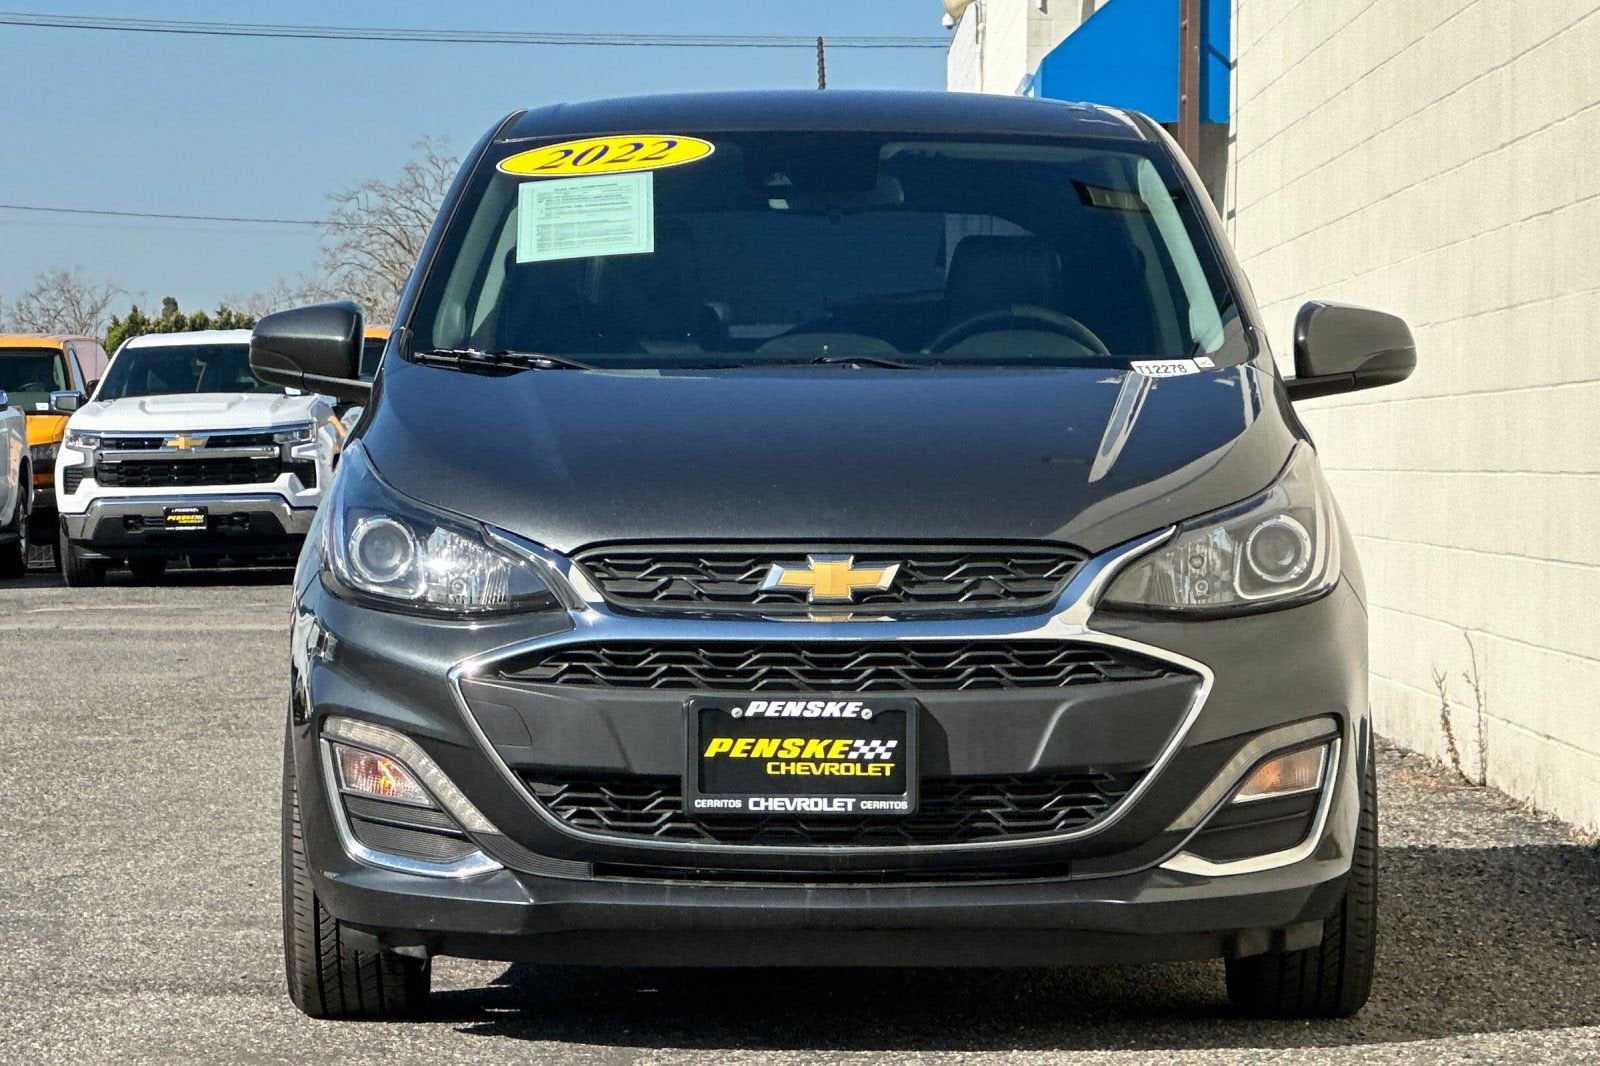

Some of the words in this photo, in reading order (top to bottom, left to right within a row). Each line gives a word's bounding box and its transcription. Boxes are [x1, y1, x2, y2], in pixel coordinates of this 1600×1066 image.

[533, 140, 678, 171] 2022
[1136, 365, 1187, 374] T12278
[744, 701, 863, 718] PENSKE
[703, 738, 853, 759] PENSKE
[766, 761, 895, 776] CHEVROLET
[694, 799, 742, 808] CERRITOS
[748, 797, 856, 811] CHEVROLET
[860, 800, 908, 810] CERRITOS
